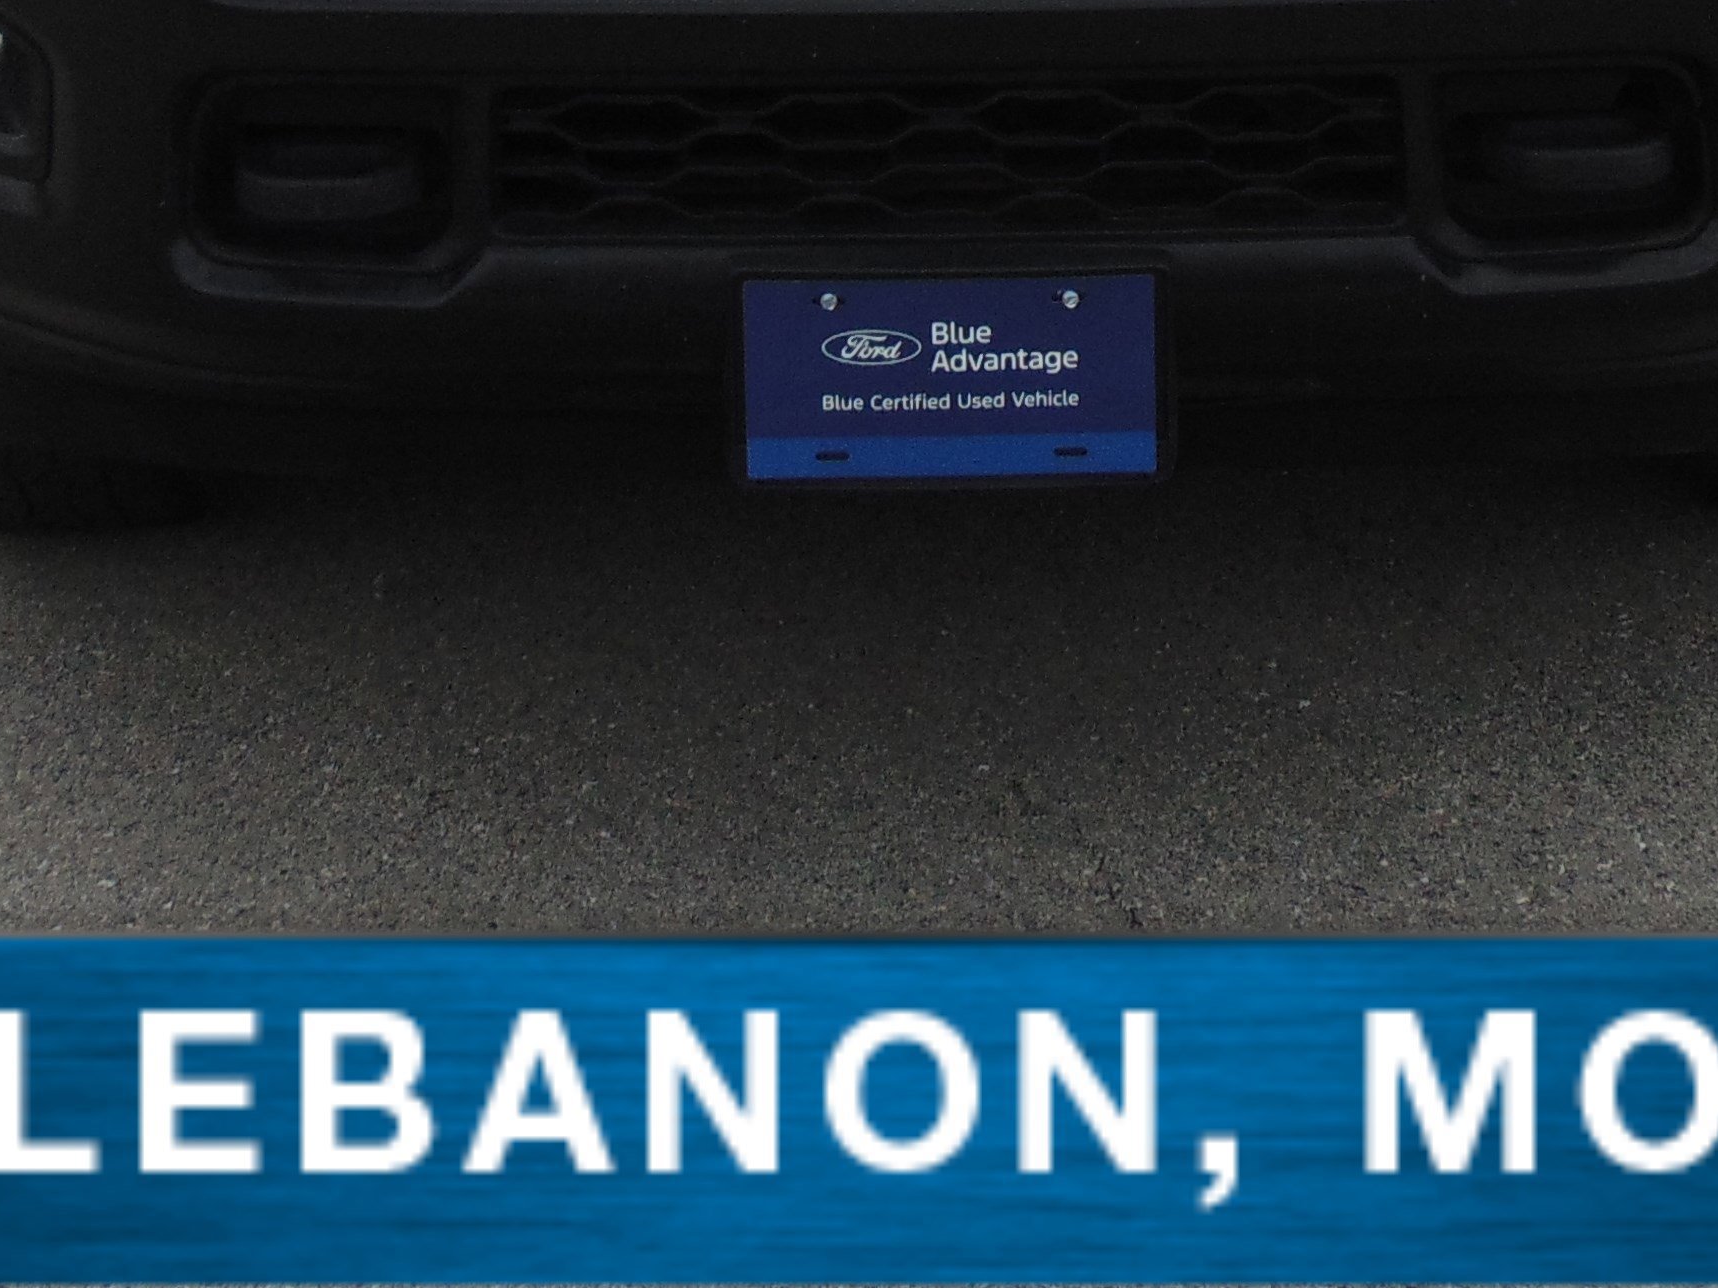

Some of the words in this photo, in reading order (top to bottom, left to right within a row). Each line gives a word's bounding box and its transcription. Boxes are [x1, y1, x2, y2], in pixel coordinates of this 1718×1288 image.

[932, 321, 992, 345] Blue
[840, 334, 902, 360] Ford
[931, 348, 1079, 374] Advantage
[822, 394, 864, 411] Blue
[870, 393, 951, 411] Certified
[957, 392, 1006, 409] Used
[1011, 389, 1080, 407] Vehicle
